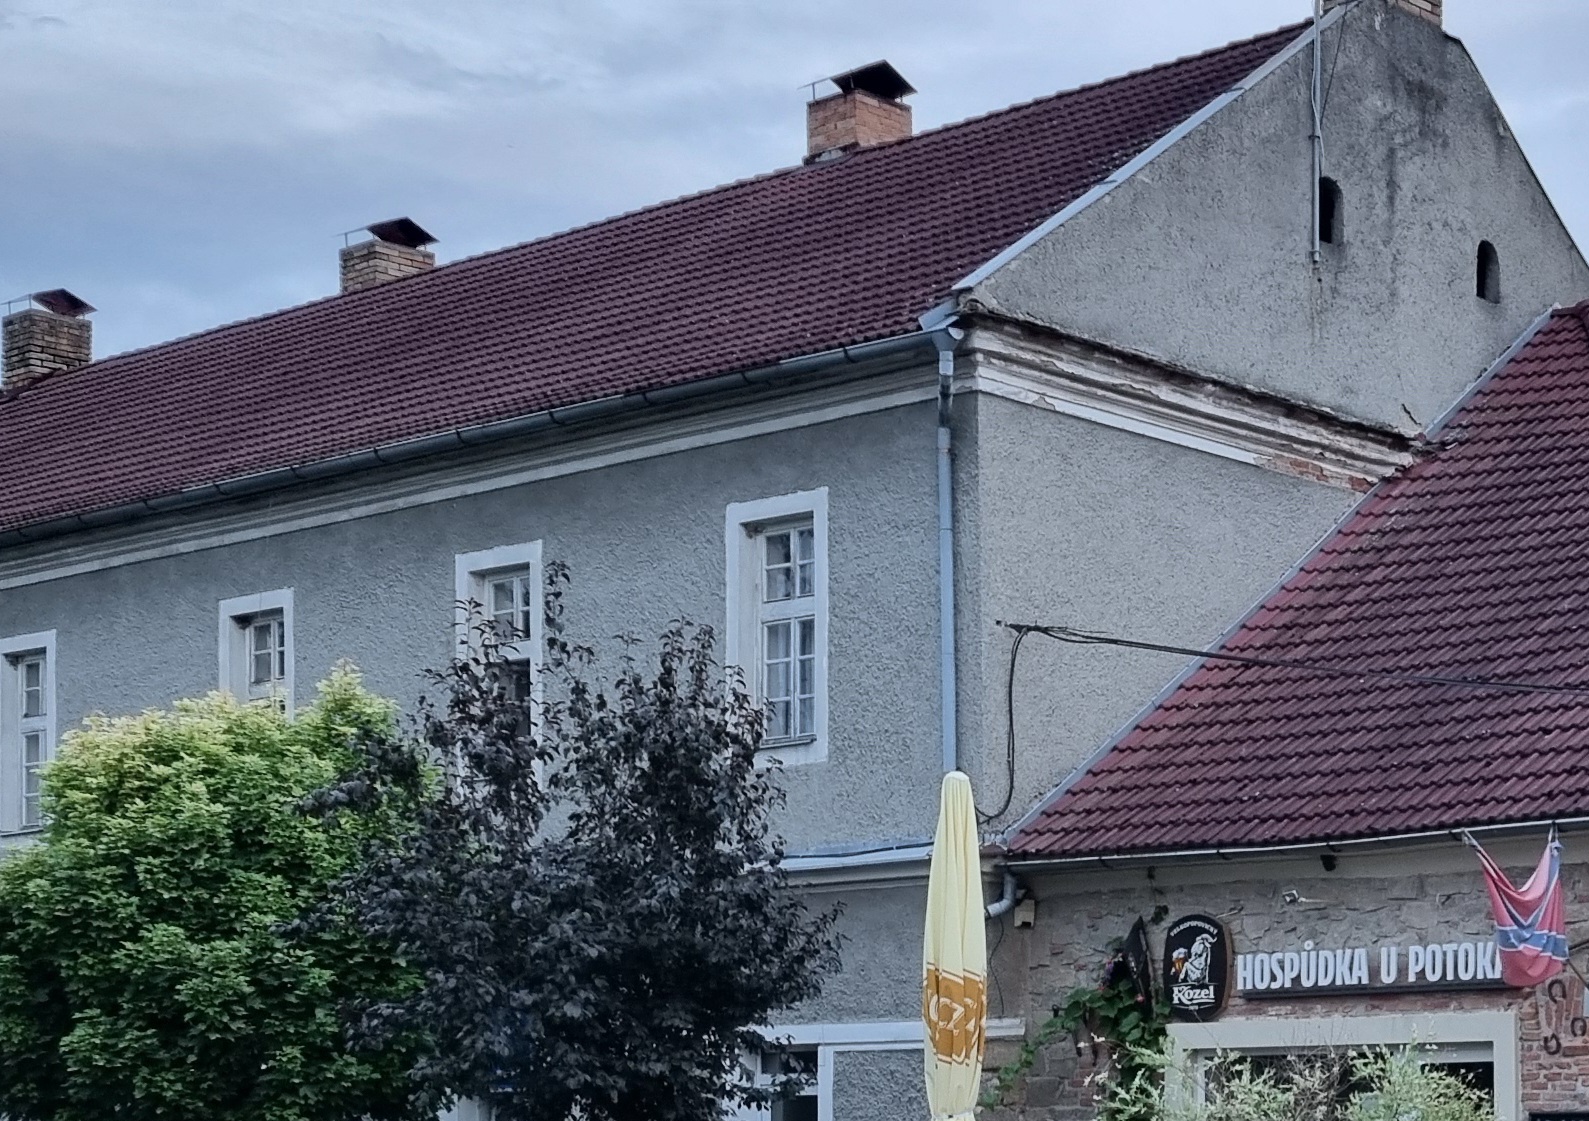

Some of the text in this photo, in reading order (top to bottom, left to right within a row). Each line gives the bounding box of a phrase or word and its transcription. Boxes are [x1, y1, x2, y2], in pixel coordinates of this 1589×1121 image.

[1236, 940, 1369, 991] HOSPŮDKA
[1380, 947, 1398, 984] U
[1172, 985, 1216, 1005] Kozel
